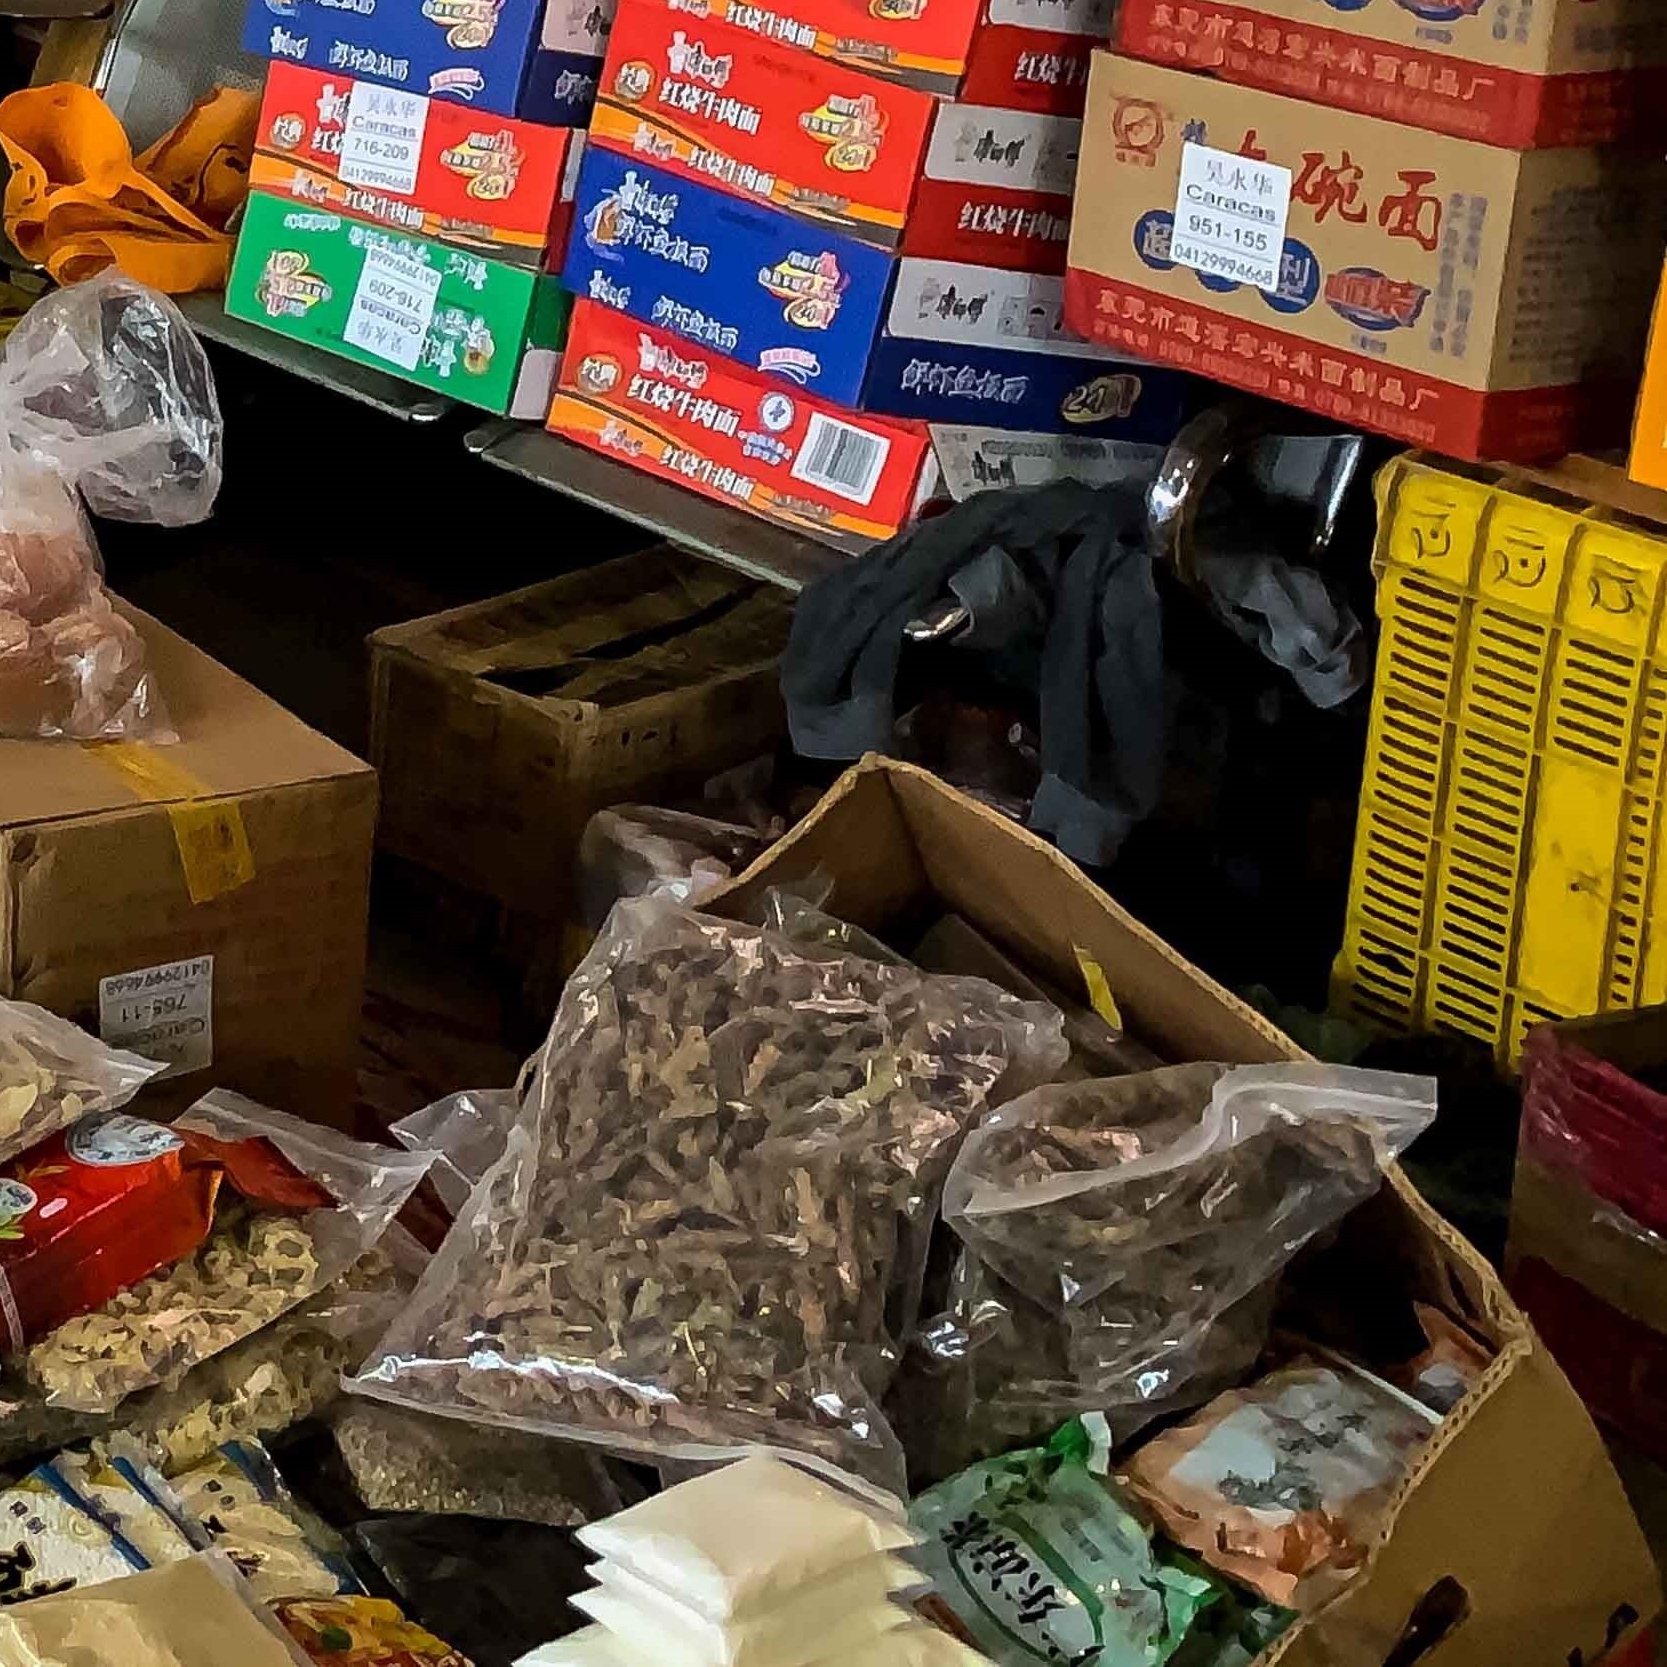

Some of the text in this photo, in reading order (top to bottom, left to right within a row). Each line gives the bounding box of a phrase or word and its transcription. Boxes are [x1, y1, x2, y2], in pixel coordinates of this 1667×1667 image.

[352, 114, 417, 139] Caracas
[658, 79, 763, 136] 红烧牛肉面
[353, 137, 409, 163] 716-209
[1185, 181, 1278, 223] Caracas
[1186, 214, 1269, 253] 951-155
[1173, 241, 1274, 287] 04129994668
[626, 374, 743, 438] 红烧牛肉面
